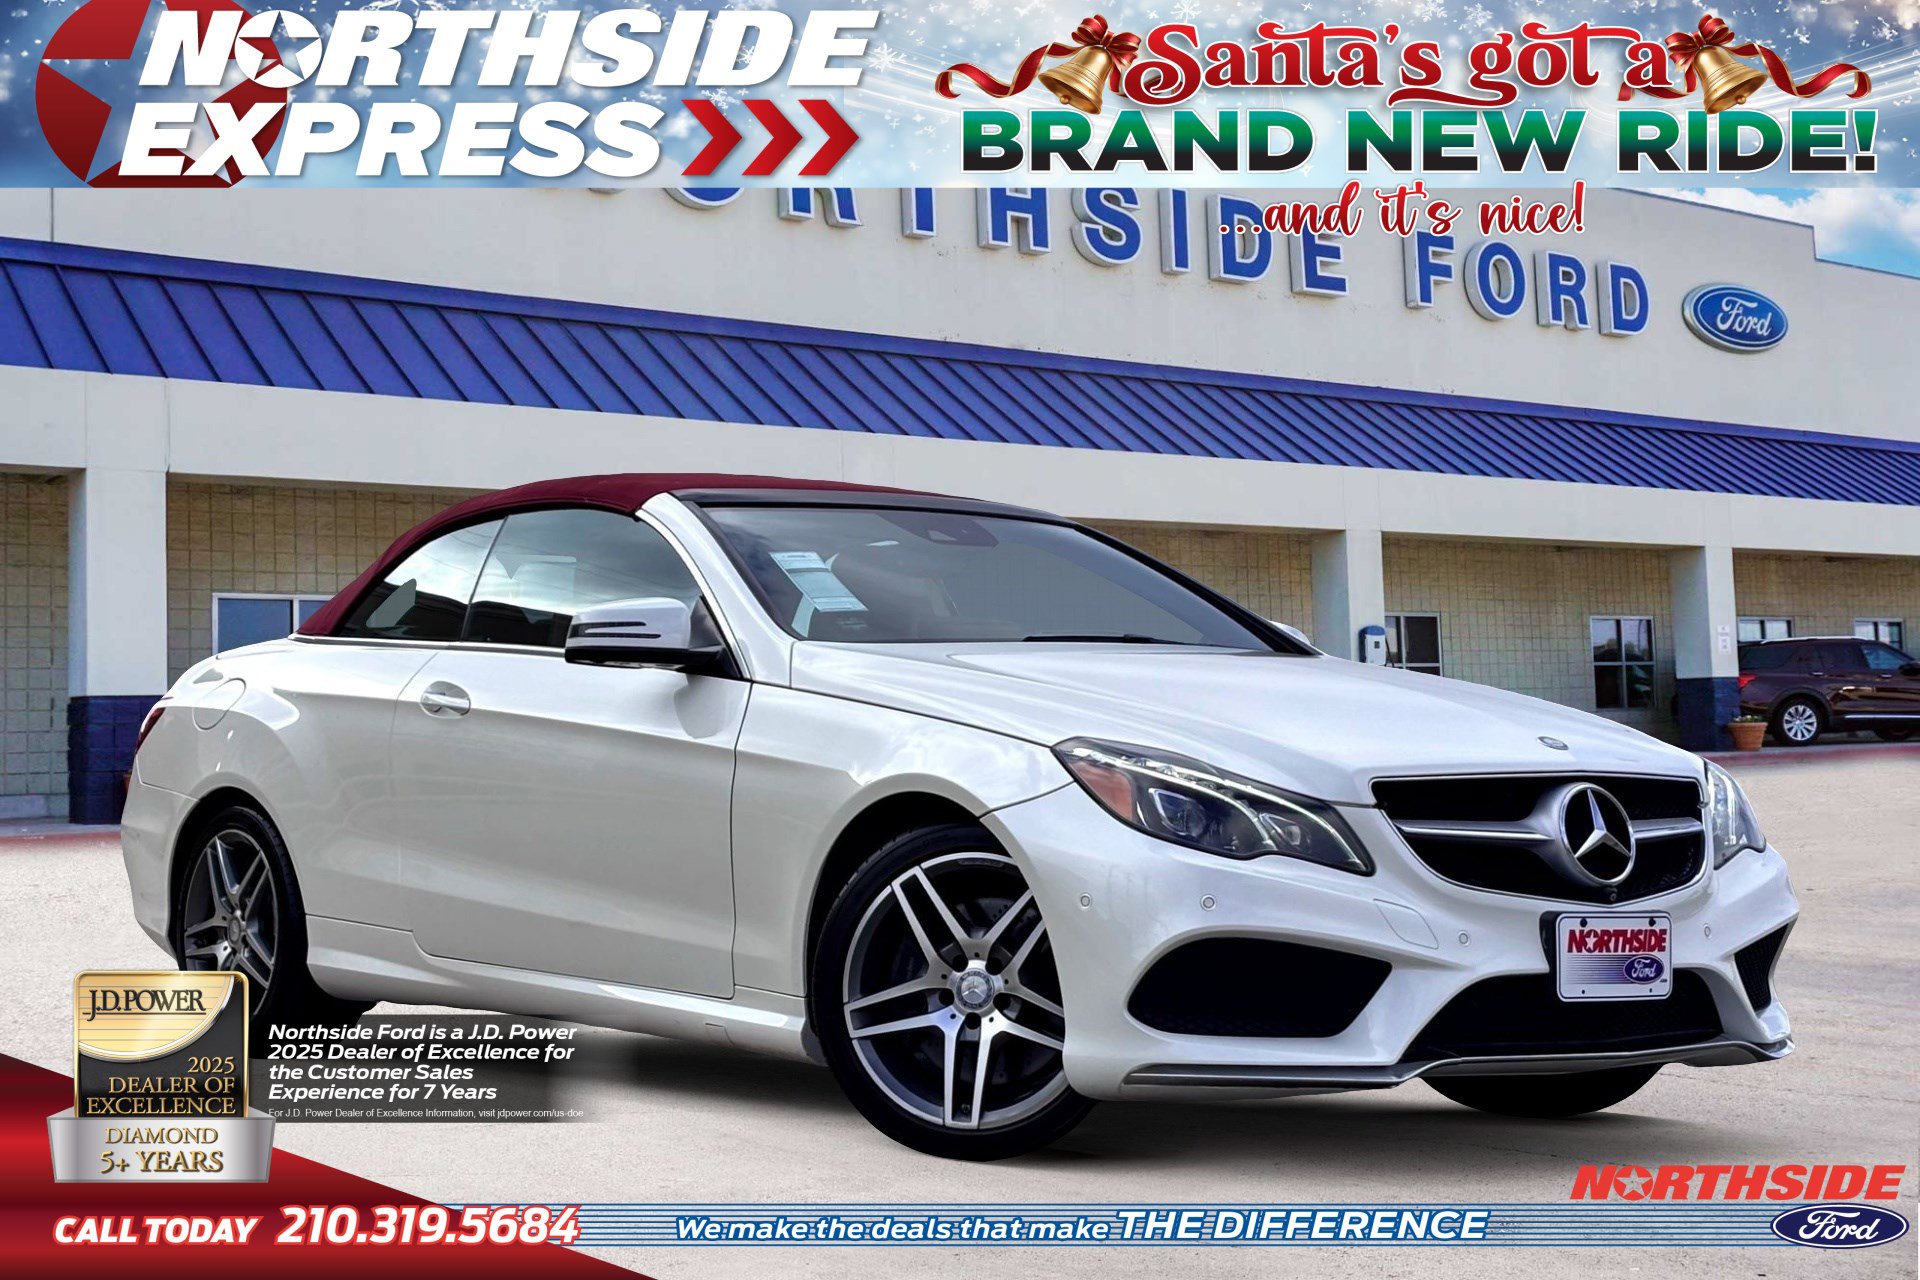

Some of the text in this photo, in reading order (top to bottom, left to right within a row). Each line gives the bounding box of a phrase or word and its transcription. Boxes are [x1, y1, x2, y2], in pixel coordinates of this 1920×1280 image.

[1404, 228, 1651, 338] FORD
[1714, 296, 1773, 337] Ford
[1567, 929, 1668, 953] NORTHSIDE
[1631, 959, 1657, 978] Ford
